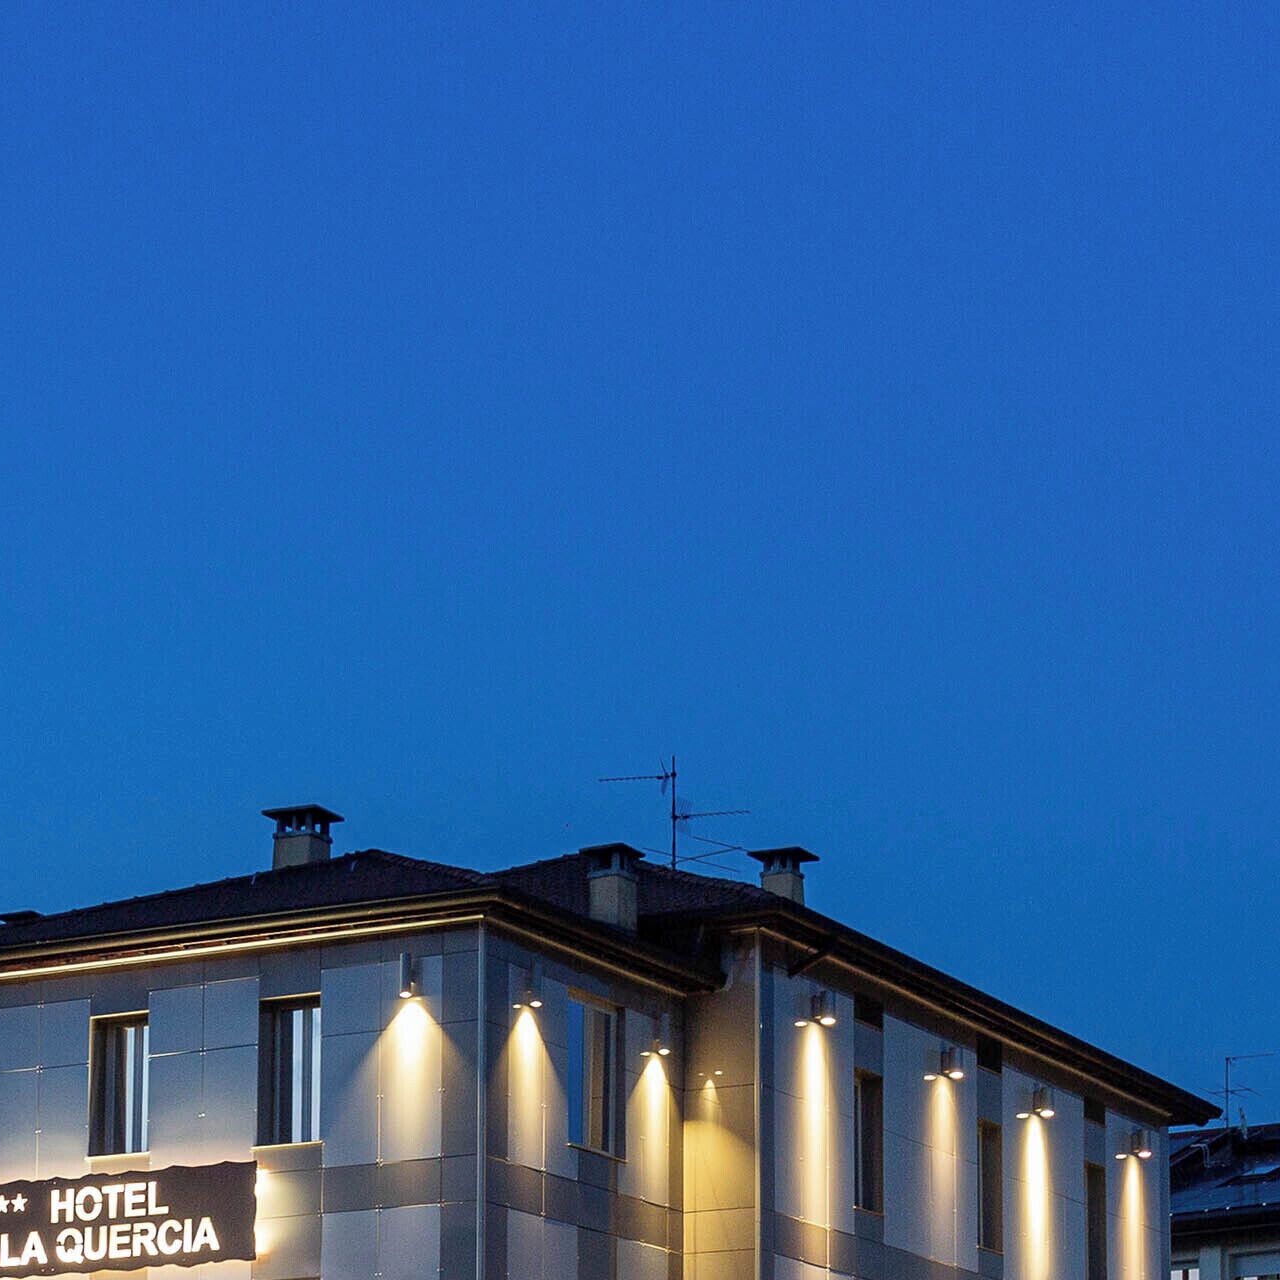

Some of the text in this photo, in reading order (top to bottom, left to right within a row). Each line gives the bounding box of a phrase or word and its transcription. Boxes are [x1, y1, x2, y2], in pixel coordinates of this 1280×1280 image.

[50, 1181, 169, 1224] HOTEL
[0, 1216, 220, 1268] LA QUERCIA
